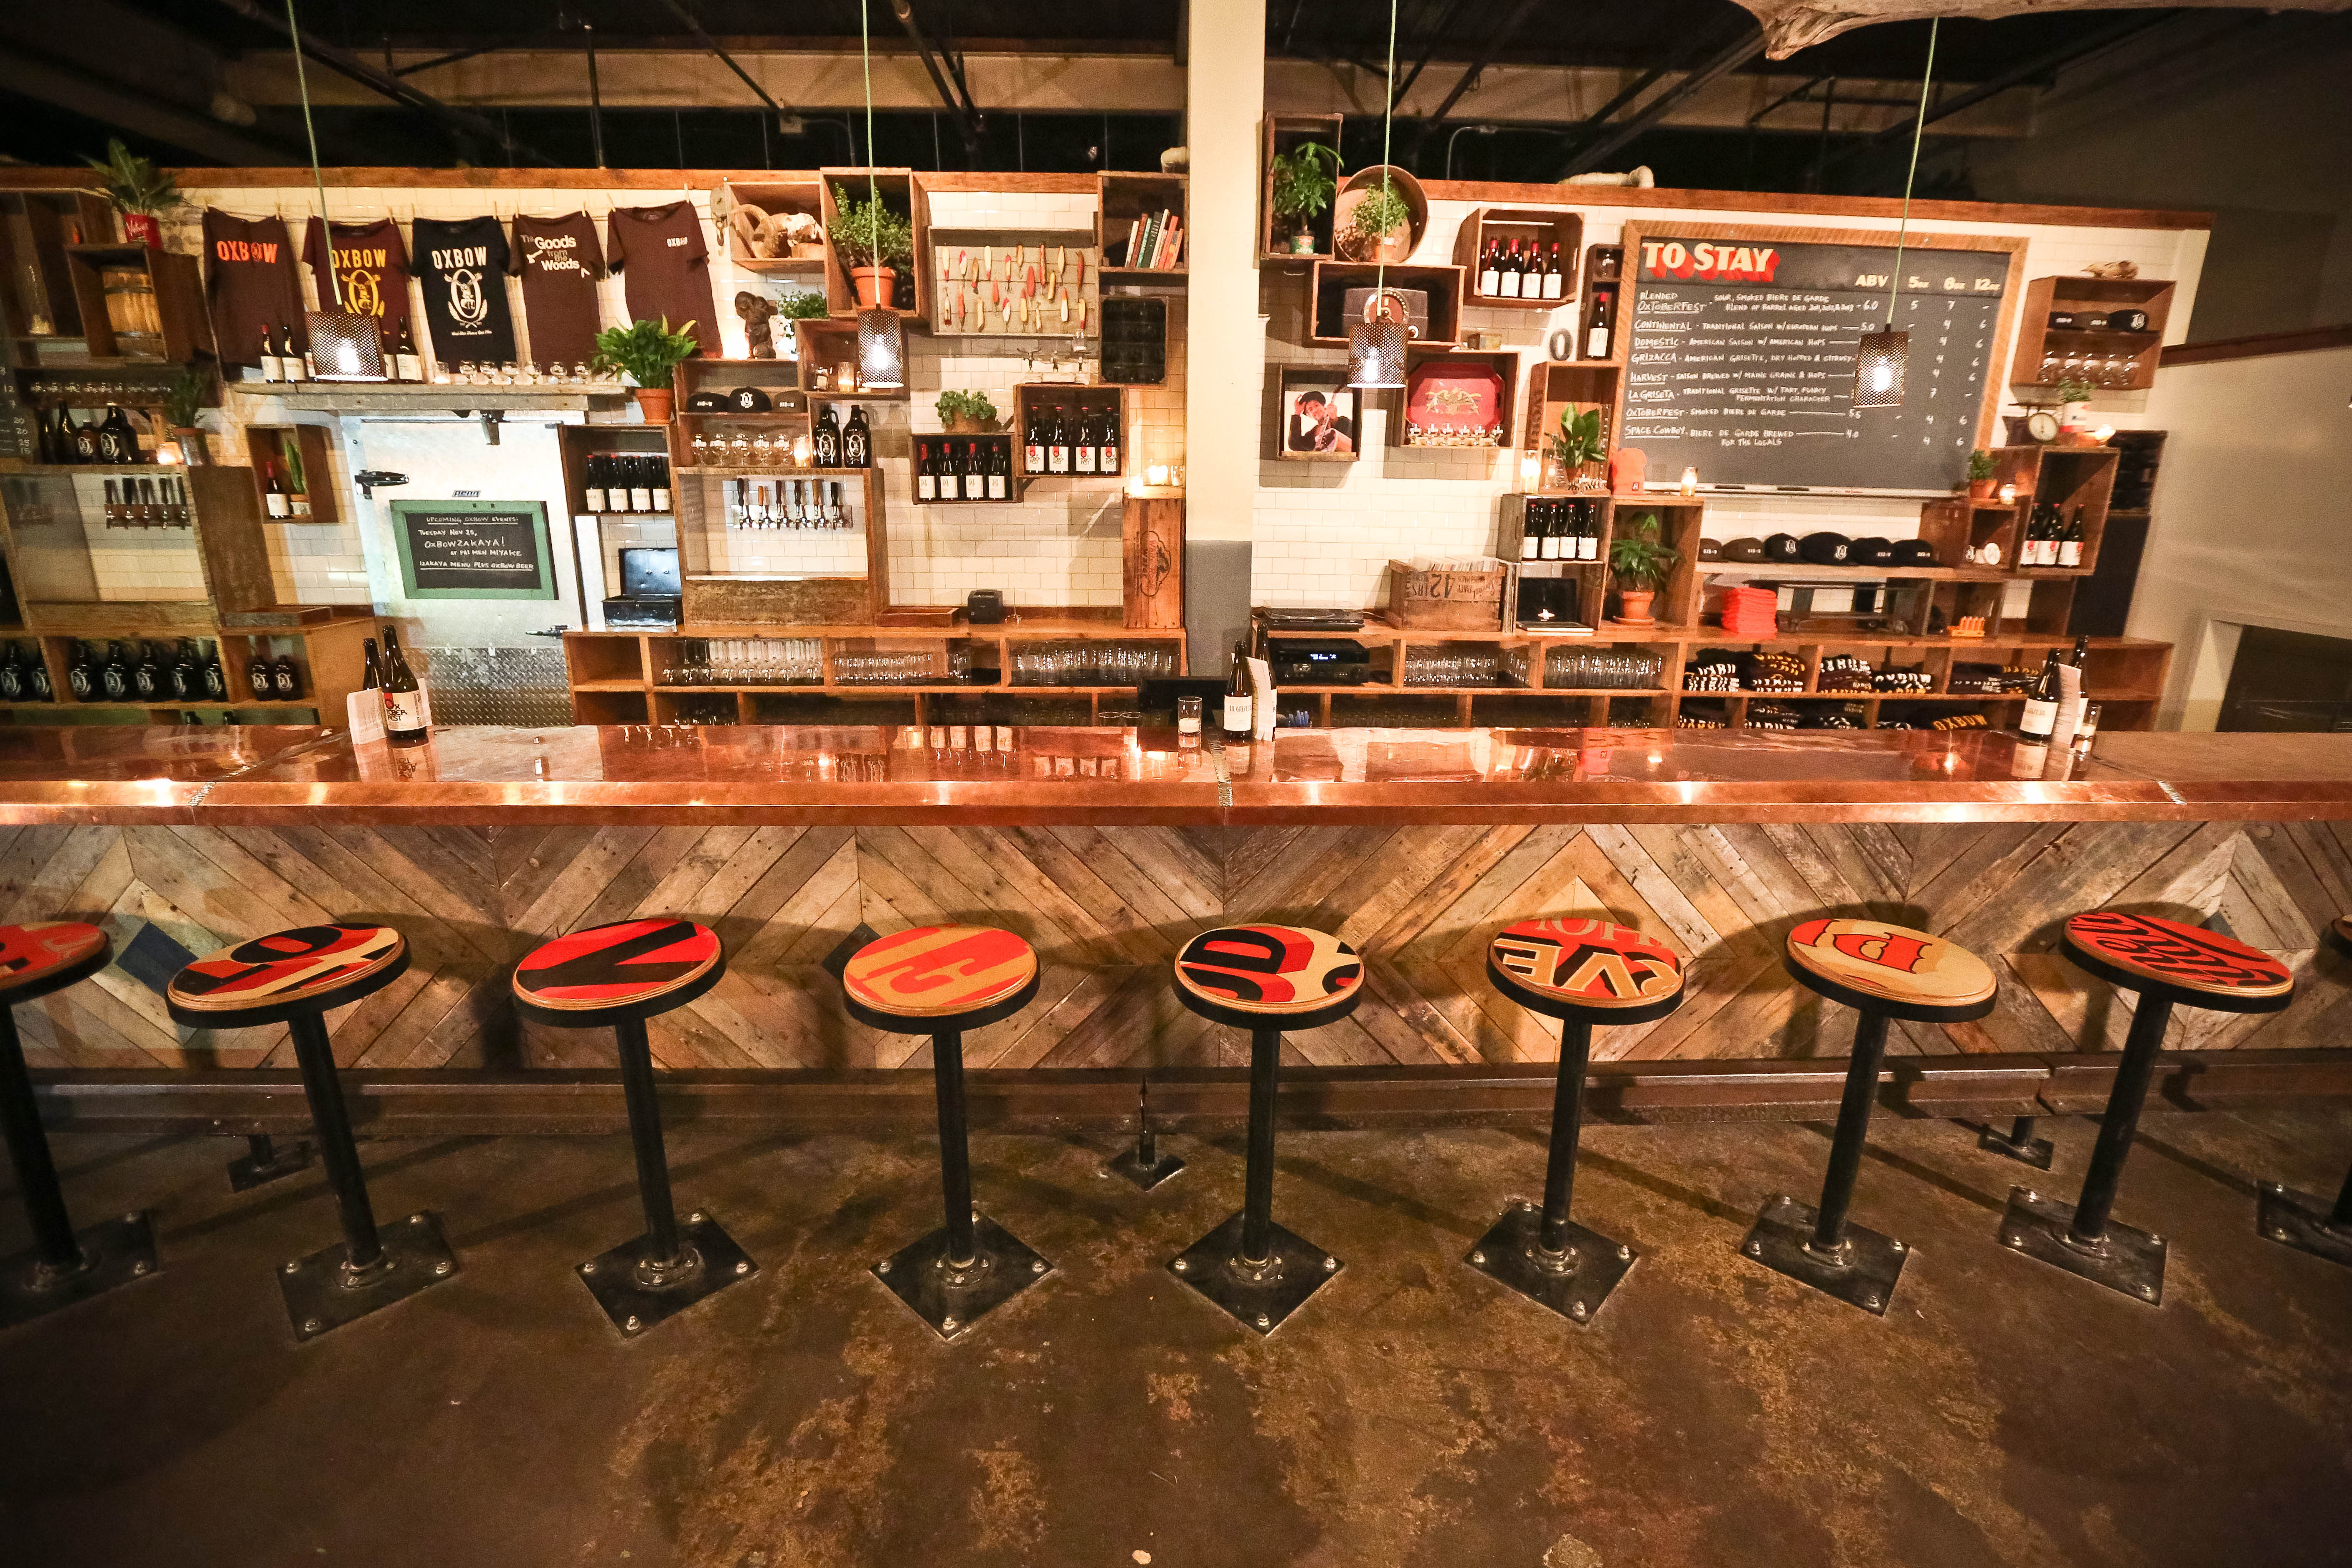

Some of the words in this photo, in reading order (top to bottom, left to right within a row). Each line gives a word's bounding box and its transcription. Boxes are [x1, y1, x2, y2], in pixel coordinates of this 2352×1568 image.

[534, 235, 576, 249] Goods
[217, 241, 278, 264] OXBOW
[332, 249, 386, 269] OXBOW
[431, 246, 487, 269] OXBOW
[1642, 242, 1688, 272] TO
[1694, 243, 1776, 275] STAY
[541, 258, 580, 271] Woods
[1855, 274, 1889, 287] ABV
[1639, 290, 1678, 300] BLENDED
[1911, 300, 1919, 310] 5
[1947, 300, 1955, 310] 7
[1634, 320, 1692, 330] CONTINENTAL
[1860, 322, 1875, 331] 5.0
[1979, 320, 1986, 329] 6
[1635, 337, 1679, 346] DOMESTIC
[1975, 339, 1984, 349] 6
[1631, 353, 1677, 364] GRIZACCA
[1971, 357, 1979, 367] 6
[1630, 372, 1669, 382] HARVEST
[1968, 373, 1976, 382] 6
[1628, 390, 1639, 399] LA
[1926, 415, 1934, 424] 4
[1959, 415, 1968, 425] 6
[1624, 425, 1651, 436] SPACE
[1654, 425, 1685, 435] COWBOY
[1735, 429, 1759, 437] GARDE
[1923, 436, 1931, 446] 4
[1956, 437, 1964, 446] 6
